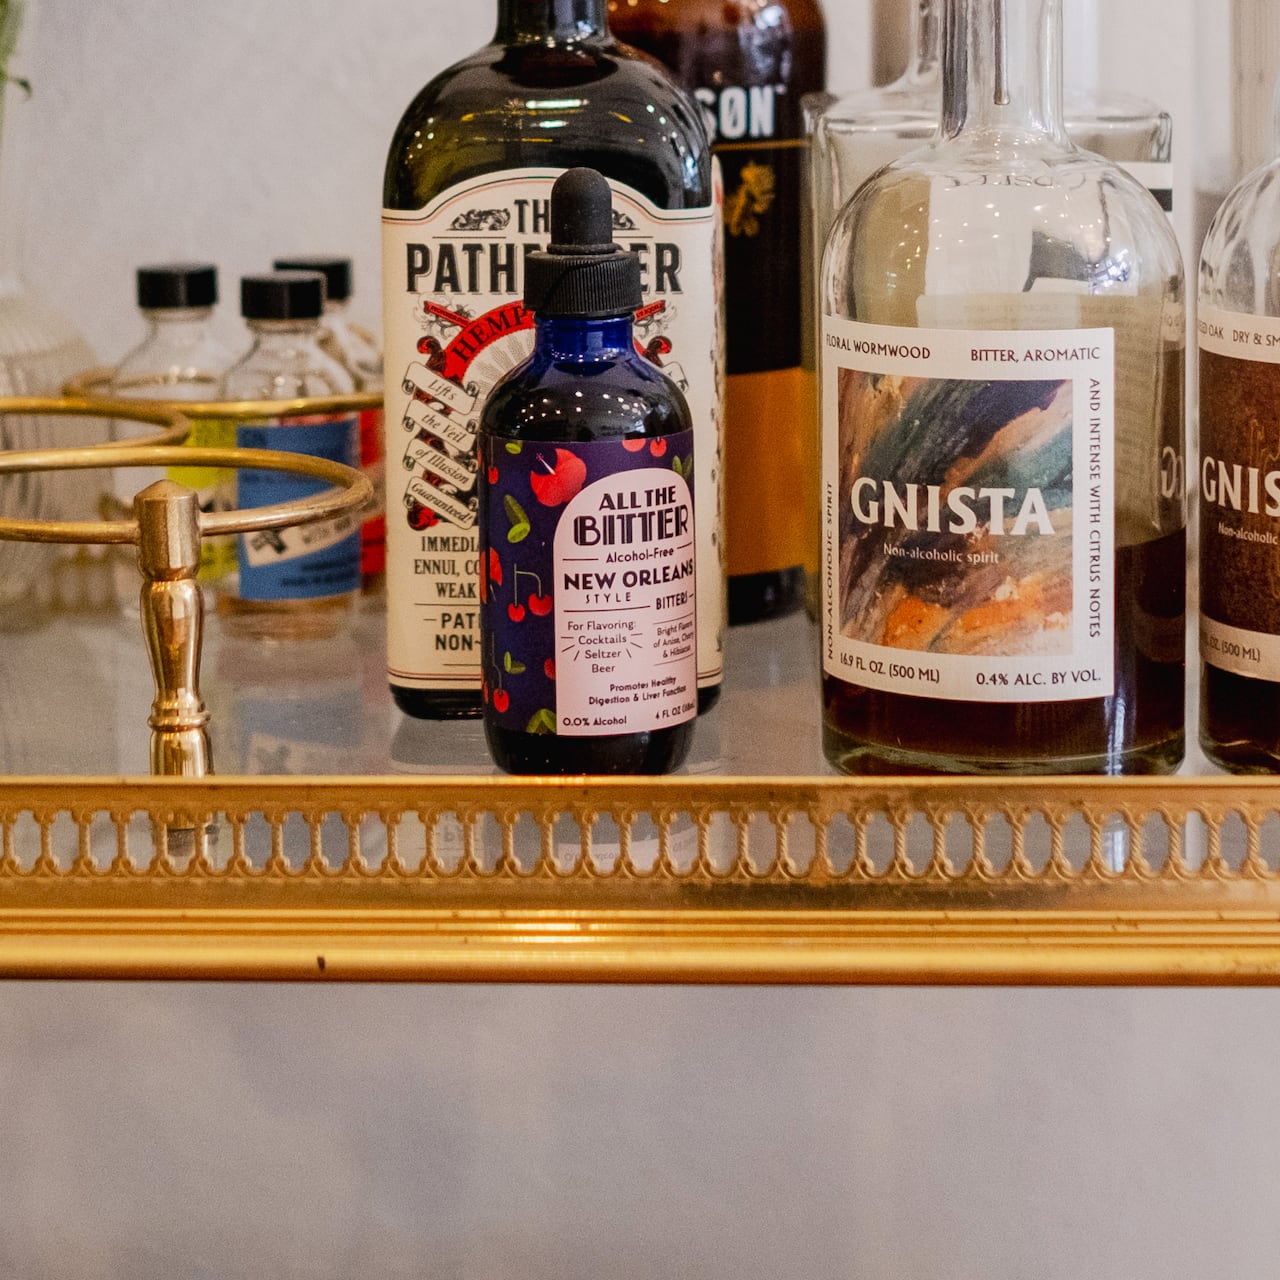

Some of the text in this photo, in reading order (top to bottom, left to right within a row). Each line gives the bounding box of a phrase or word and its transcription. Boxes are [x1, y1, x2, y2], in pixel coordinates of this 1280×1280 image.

[513, 198, 551, 235] TH
[406, 242, 683, 295] PATHER
[451, 304, 528, 362] HEMP
[1208, 324, 1224, 340] OAK
[1232, 329, 1250, 345] DRY
[1253, 332, 1263, 345] &
[826, 333, 931, 359] FLORAL WORMWOOD
[970, 347, 1102, 363] BITTER, AROMATIC
[428, 378, 457, 401] Lifts
[421, 413, 467, 444] the Veil
[415, 447, 470, 485] of Illusion
[411, 482, 473, 524] Guaranteed!
[599, 485, 677, 511] ALL THE
[850, 476, 1056, 536] GNISTA
[1089, 378, 1101, 638] AND INTENSE WITH CITRUS NOTES
[573, 503, 688, 546] BITTER
[1218, 521, 1278, 546] Non-alcoholic
[606, 547, 674, 564] Alcohol-Free
[883, 542, 999, 565] Non-alcoholic spirit
[413, 559, 460, 577] ENNUI,
[564, 558, 693, 590] NEW ORLEANS
[435, 582, 477, 599] WEAK
[585, 591, 632, 604] STYLE
[826, 529, 834, 660] NON-ALCOHOLIC
[441, 613, 481, 629] PAT
[567, 621, 583, 631] For
[578, 634, 627, 645] Cocktails
[653, 639, 661, 648] of
[585, 649, 622, 659] Seltzer
[663, 650, 668, 658] &
[1221, 640, 1240, 657] (500
[1242, 646, 1261, 663] ML)
[591, 663, 615, 673] Beer
[889, 663, 916, 680] (500
[918, 668, 940, 684] ML)
[610, 681, 649, 692] Promotes
[976, 669, 1101, 686] 0.4% ALC. BY VOL.
[588, 696, 630, 706] Digestion
[633, 693, 639, 702] &
[642, 691, 660, 701] Liver
[562, 715, 627, 727] 0.0% Alcohol
[662, 709, 670, 719] FL
[672, 706, 681, 716] OZ
